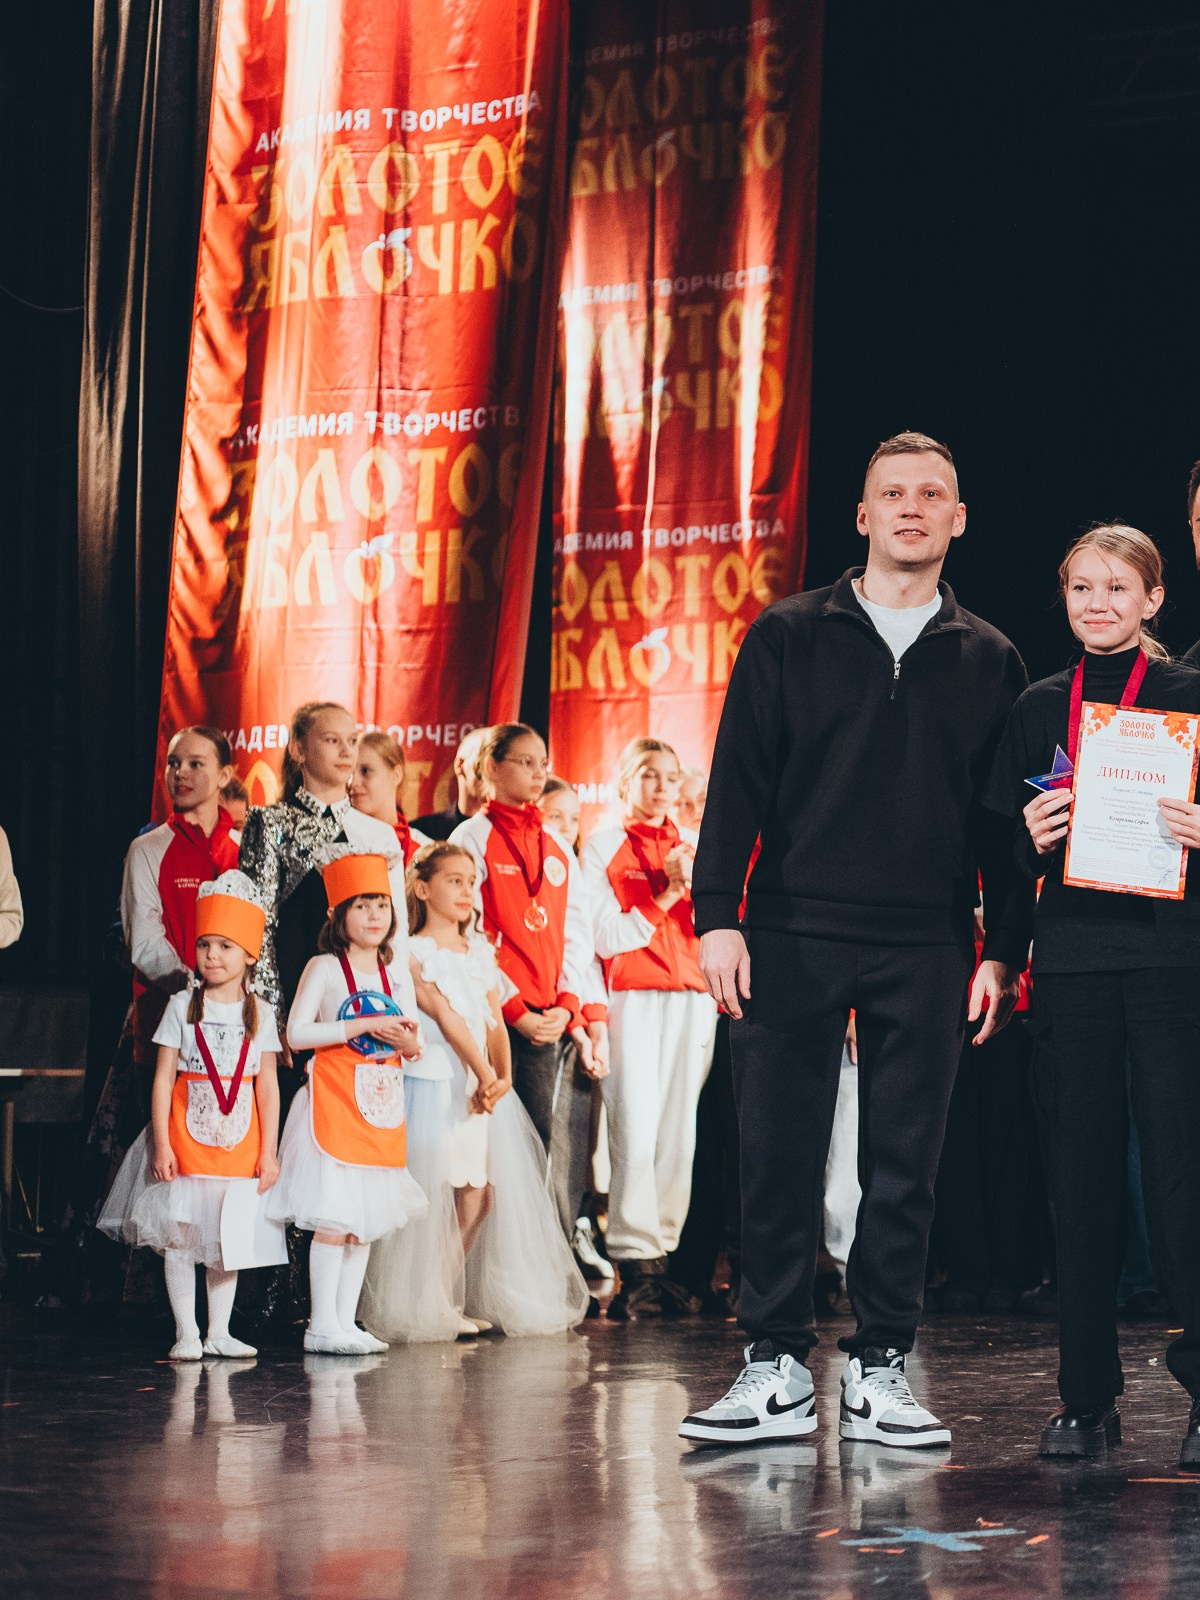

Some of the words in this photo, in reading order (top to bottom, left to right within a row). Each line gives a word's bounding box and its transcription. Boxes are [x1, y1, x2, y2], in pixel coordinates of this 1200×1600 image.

[254, 107, 371, 154] АКАДЕМИЯ
[381, 90, 542, 133] ТВОРЧЕСТВА
[244, 213, 540, 313] ЯБЛОЧКО
[642, 518, 785, 550] ТВОРЧЕСТВА
[1097, 766, 1166, 784] ДИПЛОМ
